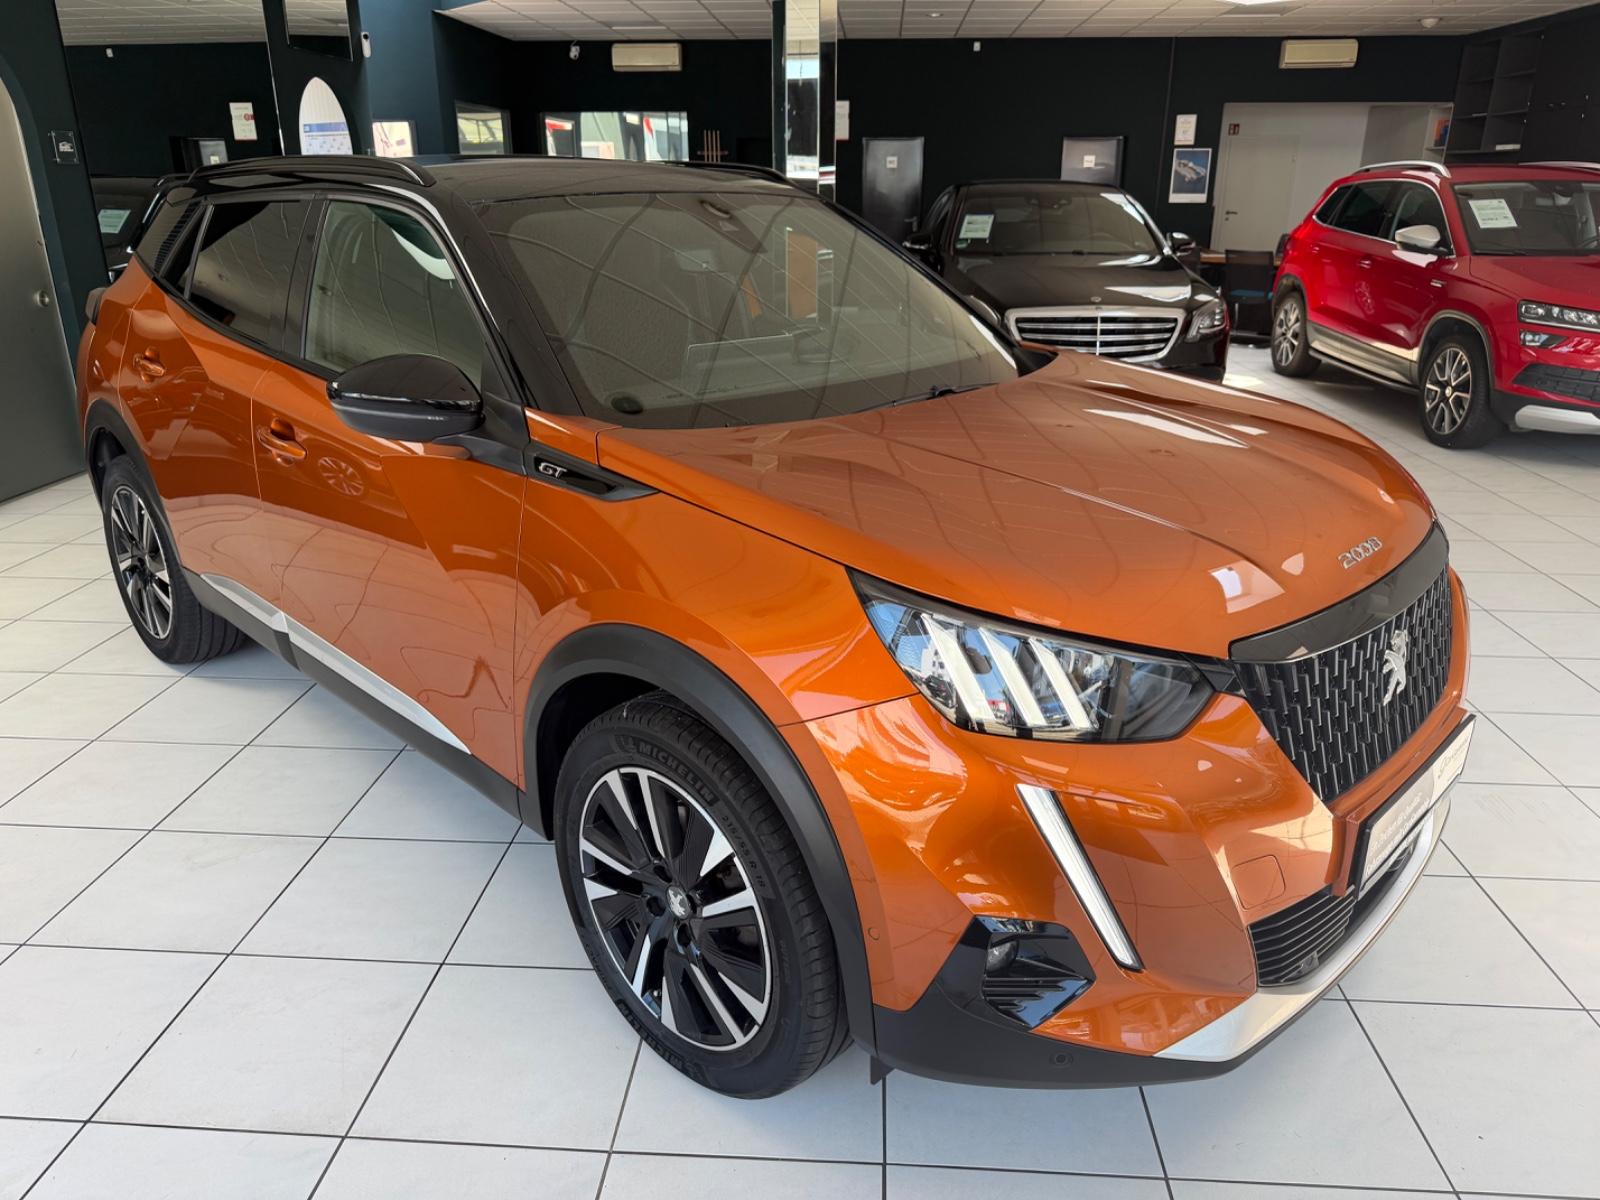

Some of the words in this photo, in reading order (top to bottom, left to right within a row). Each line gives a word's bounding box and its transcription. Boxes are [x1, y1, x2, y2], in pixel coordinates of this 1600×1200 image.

[539, 462, 567, 478] GT
[1338, 537, 1382, 568] 2008
[639, 742, 717, 805] MICHELIN
